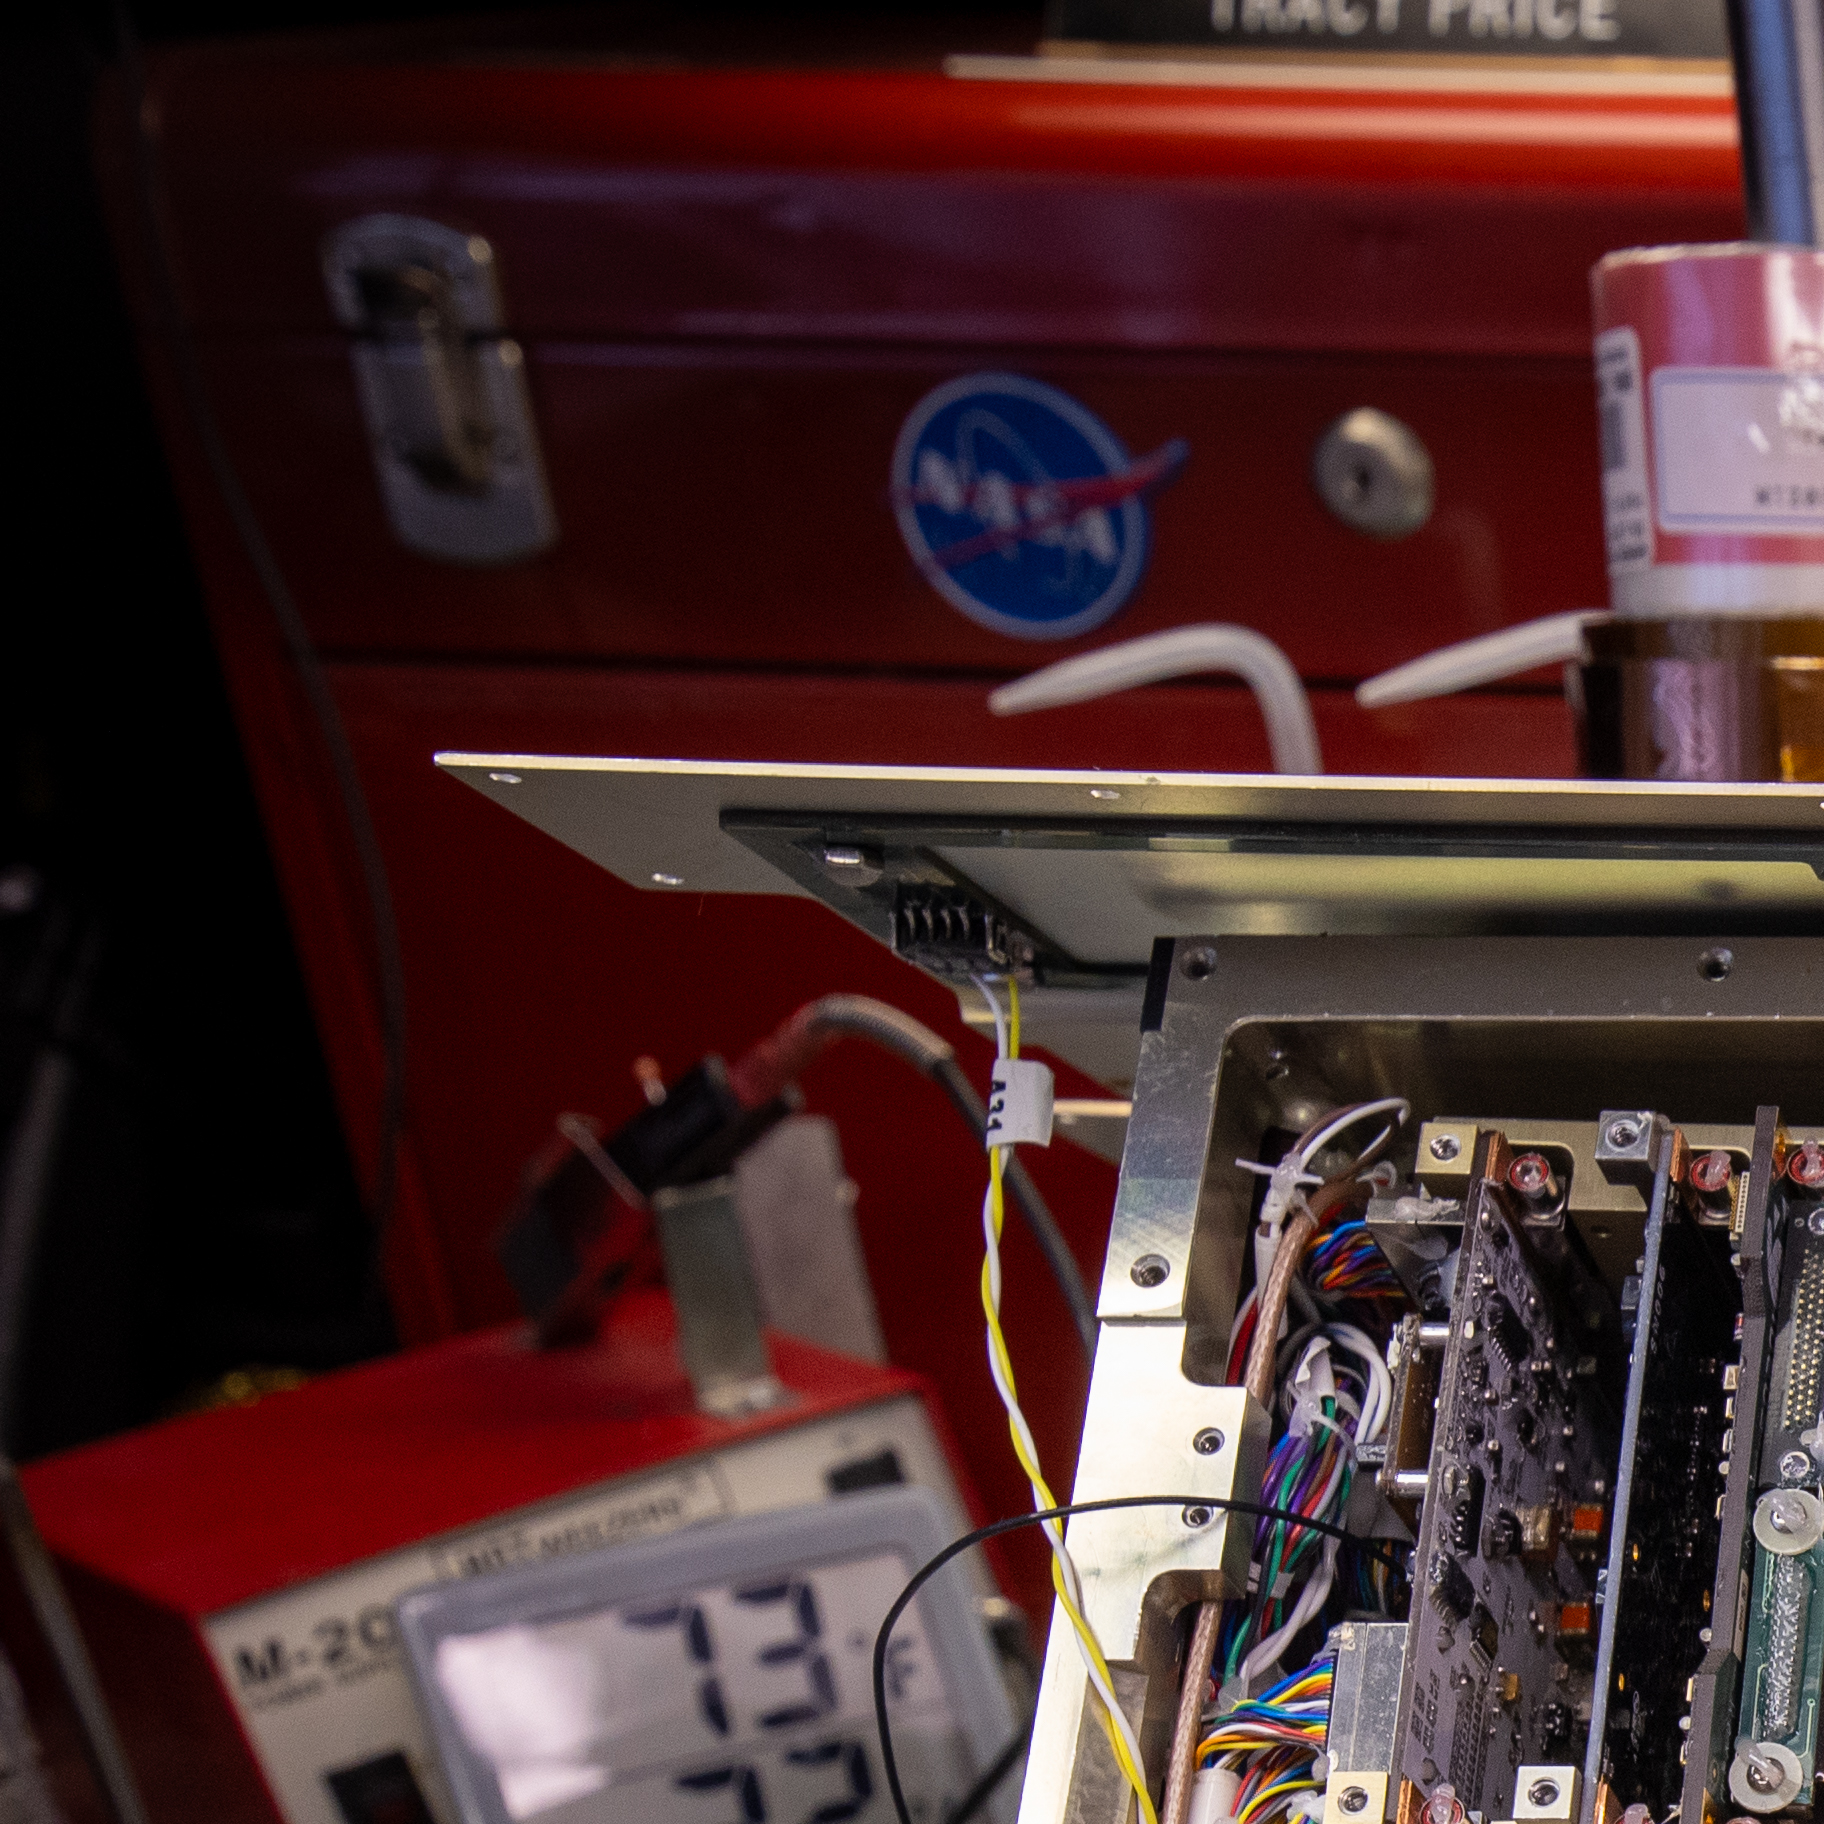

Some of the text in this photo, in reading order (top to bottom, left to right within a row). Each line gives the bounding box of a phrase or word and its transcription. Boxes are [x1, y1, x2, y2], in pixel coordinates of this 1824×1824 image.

[1427, 0, 1622, 41] PRICE
[916, 447, 1118, 566] NASA
[626, 1575, 840, 1738] 73
